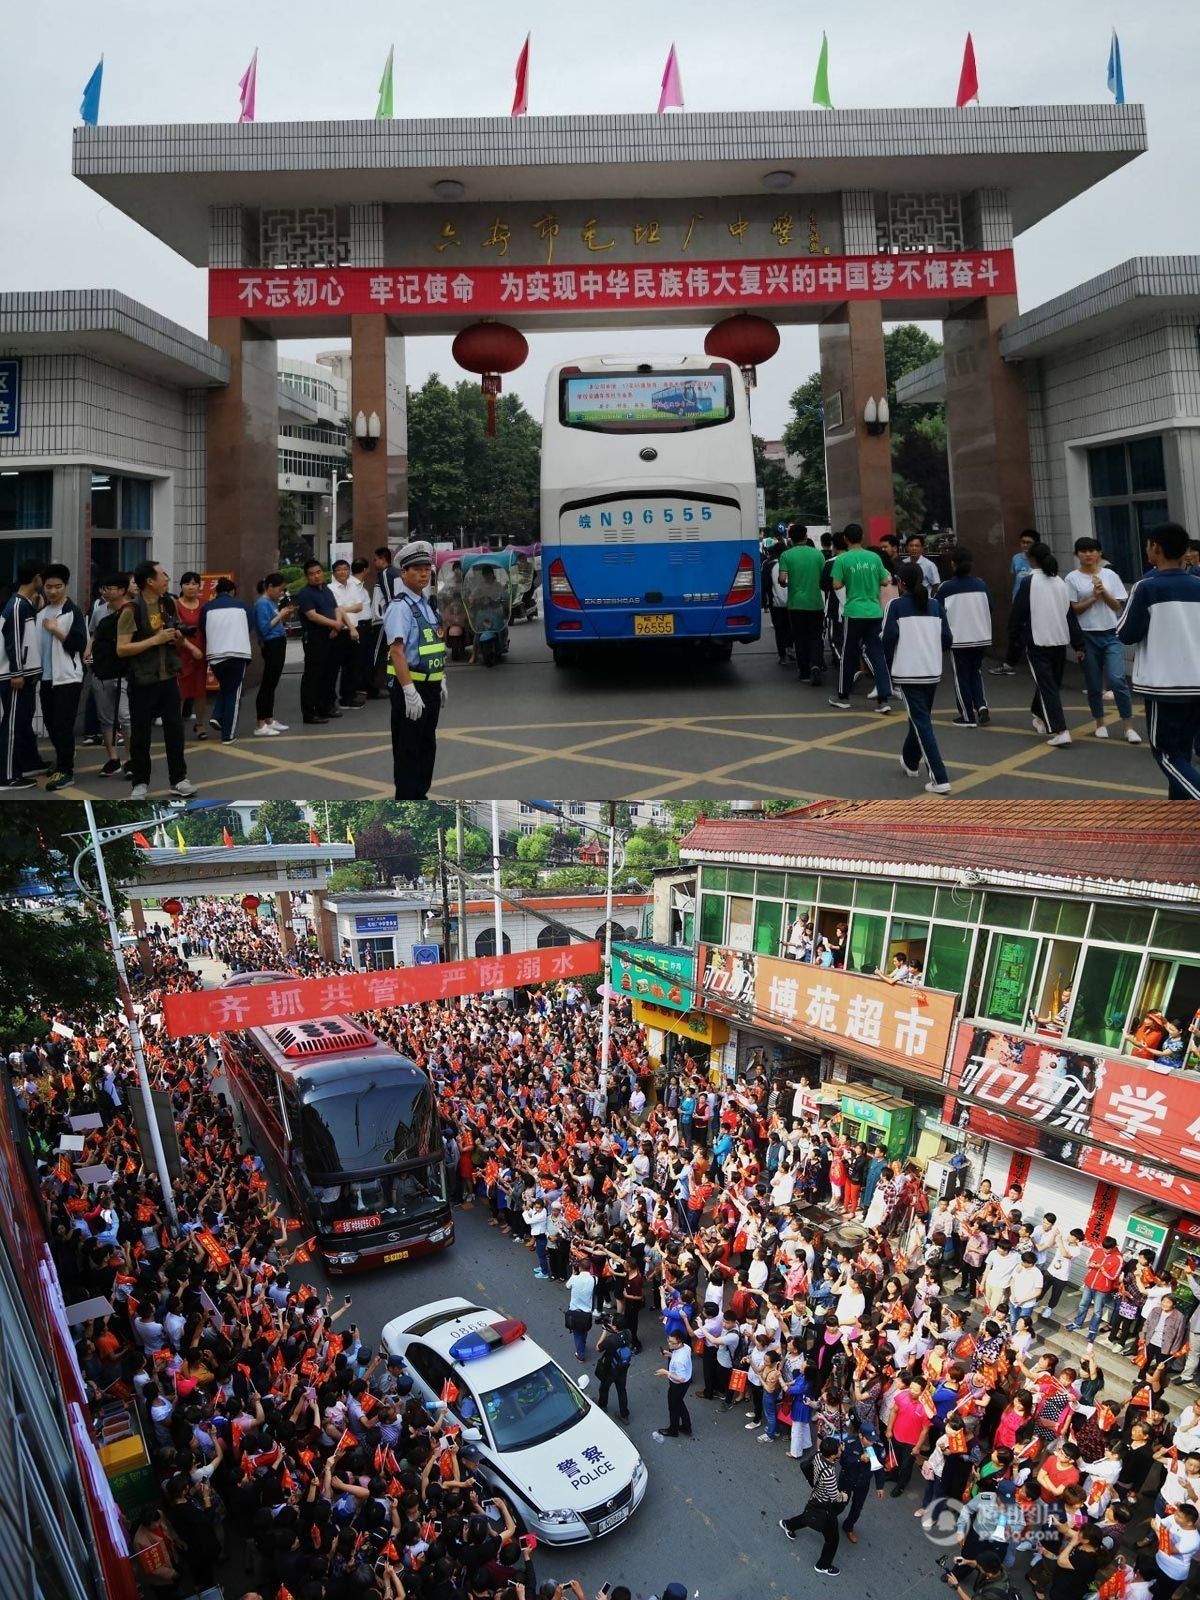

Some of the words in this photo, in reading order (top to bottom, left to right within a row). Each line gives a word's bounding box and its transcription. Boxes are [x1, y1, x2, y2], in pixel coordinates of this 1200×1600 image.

[237, 276, 345, 308] 不忘初心
[369, 272, 475, 306] 牢记使命
[500, 258, 999, 302] 为实现中华民族伟大复兴的中国梦不懈奋斗
[578, 507, 712, 529] 皖N96555
[636, 621, 673, 634] 96555
[213, 978, 398, 1024] 齐抓共管
[440, 951, 574, 993] 严防溺水
[768, 975, 935, 1057] 博苑超市
[958, 1055, 1096, 1136] 可口可乐
[1104, 1084, 1200, 1160] 学
[450, 1319, 488, 1339] 0866
[556, 1445, 605, 1479] 警察
[571, 1460, 616, 1491] POLICE
